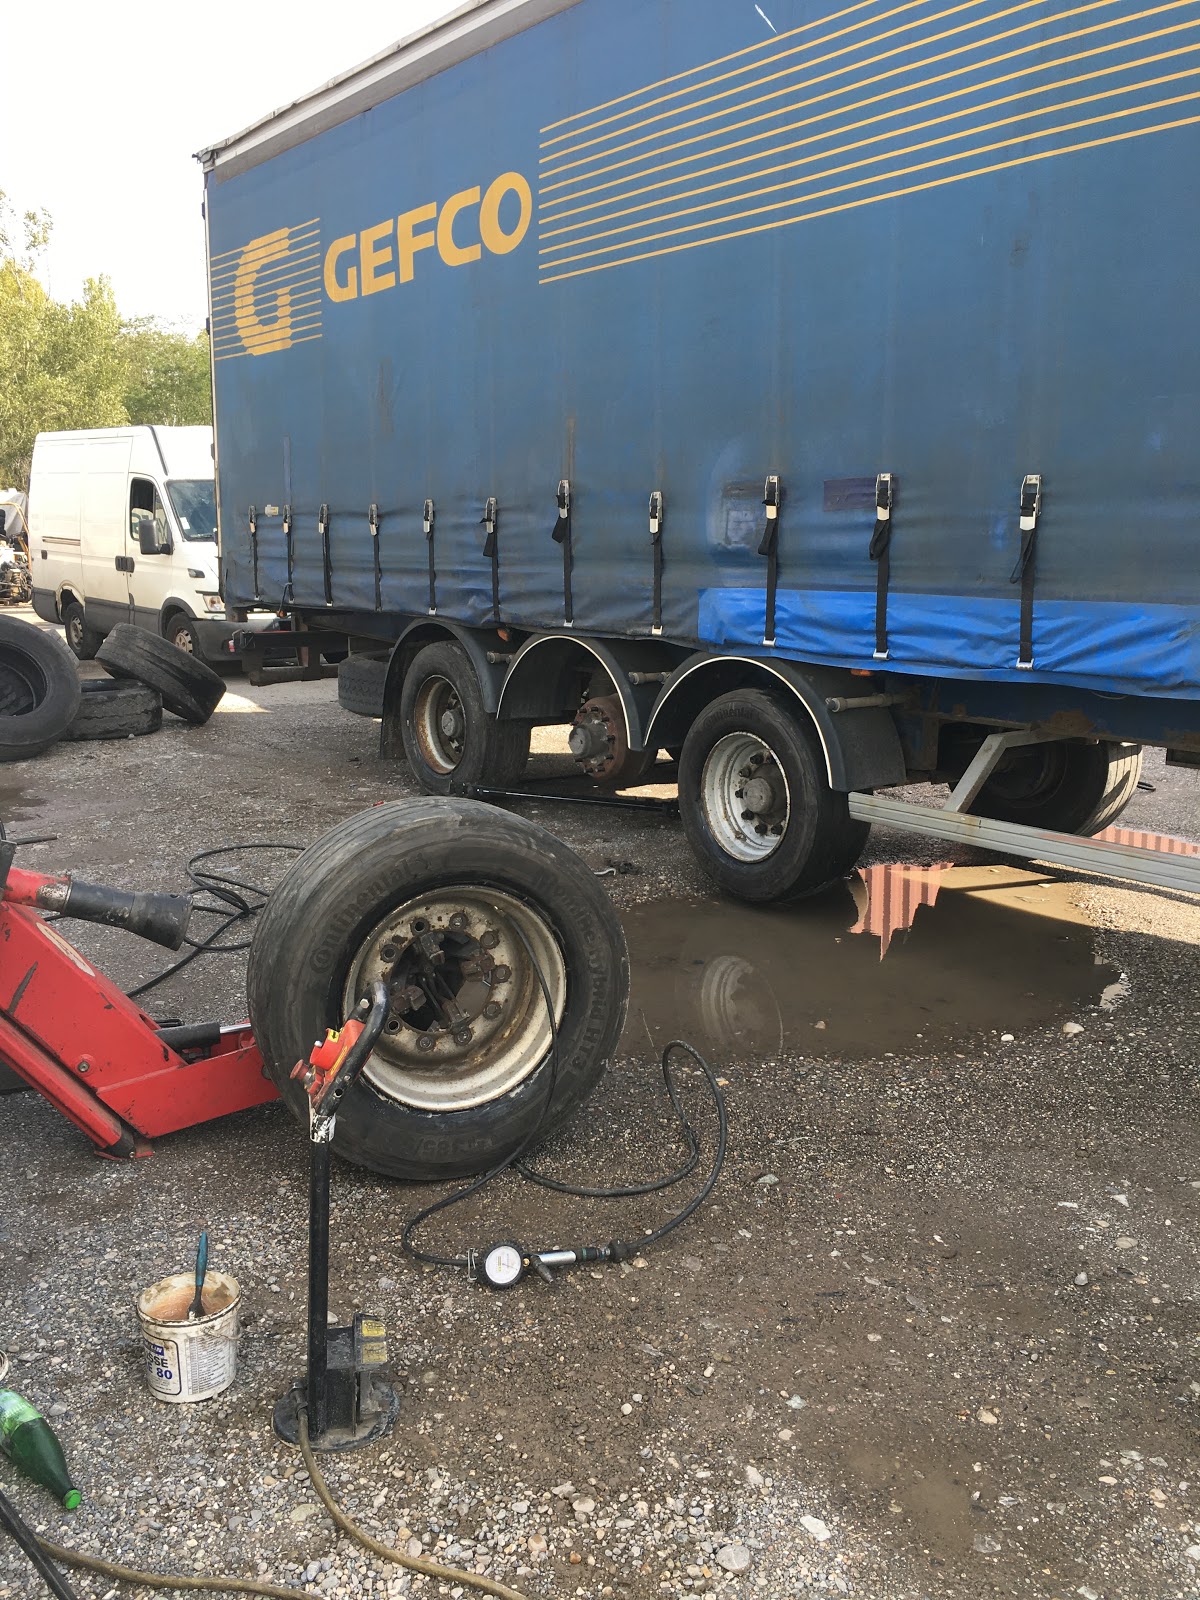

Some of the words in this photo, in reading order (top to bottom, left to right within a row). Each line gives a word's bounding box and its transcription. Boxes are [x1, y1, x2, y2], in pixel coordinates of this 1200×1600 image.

[323, 171, 533, 303] GEFCO
[309, 858, 413, 974] Continental
[156, 1367, 173, 1380] 80
